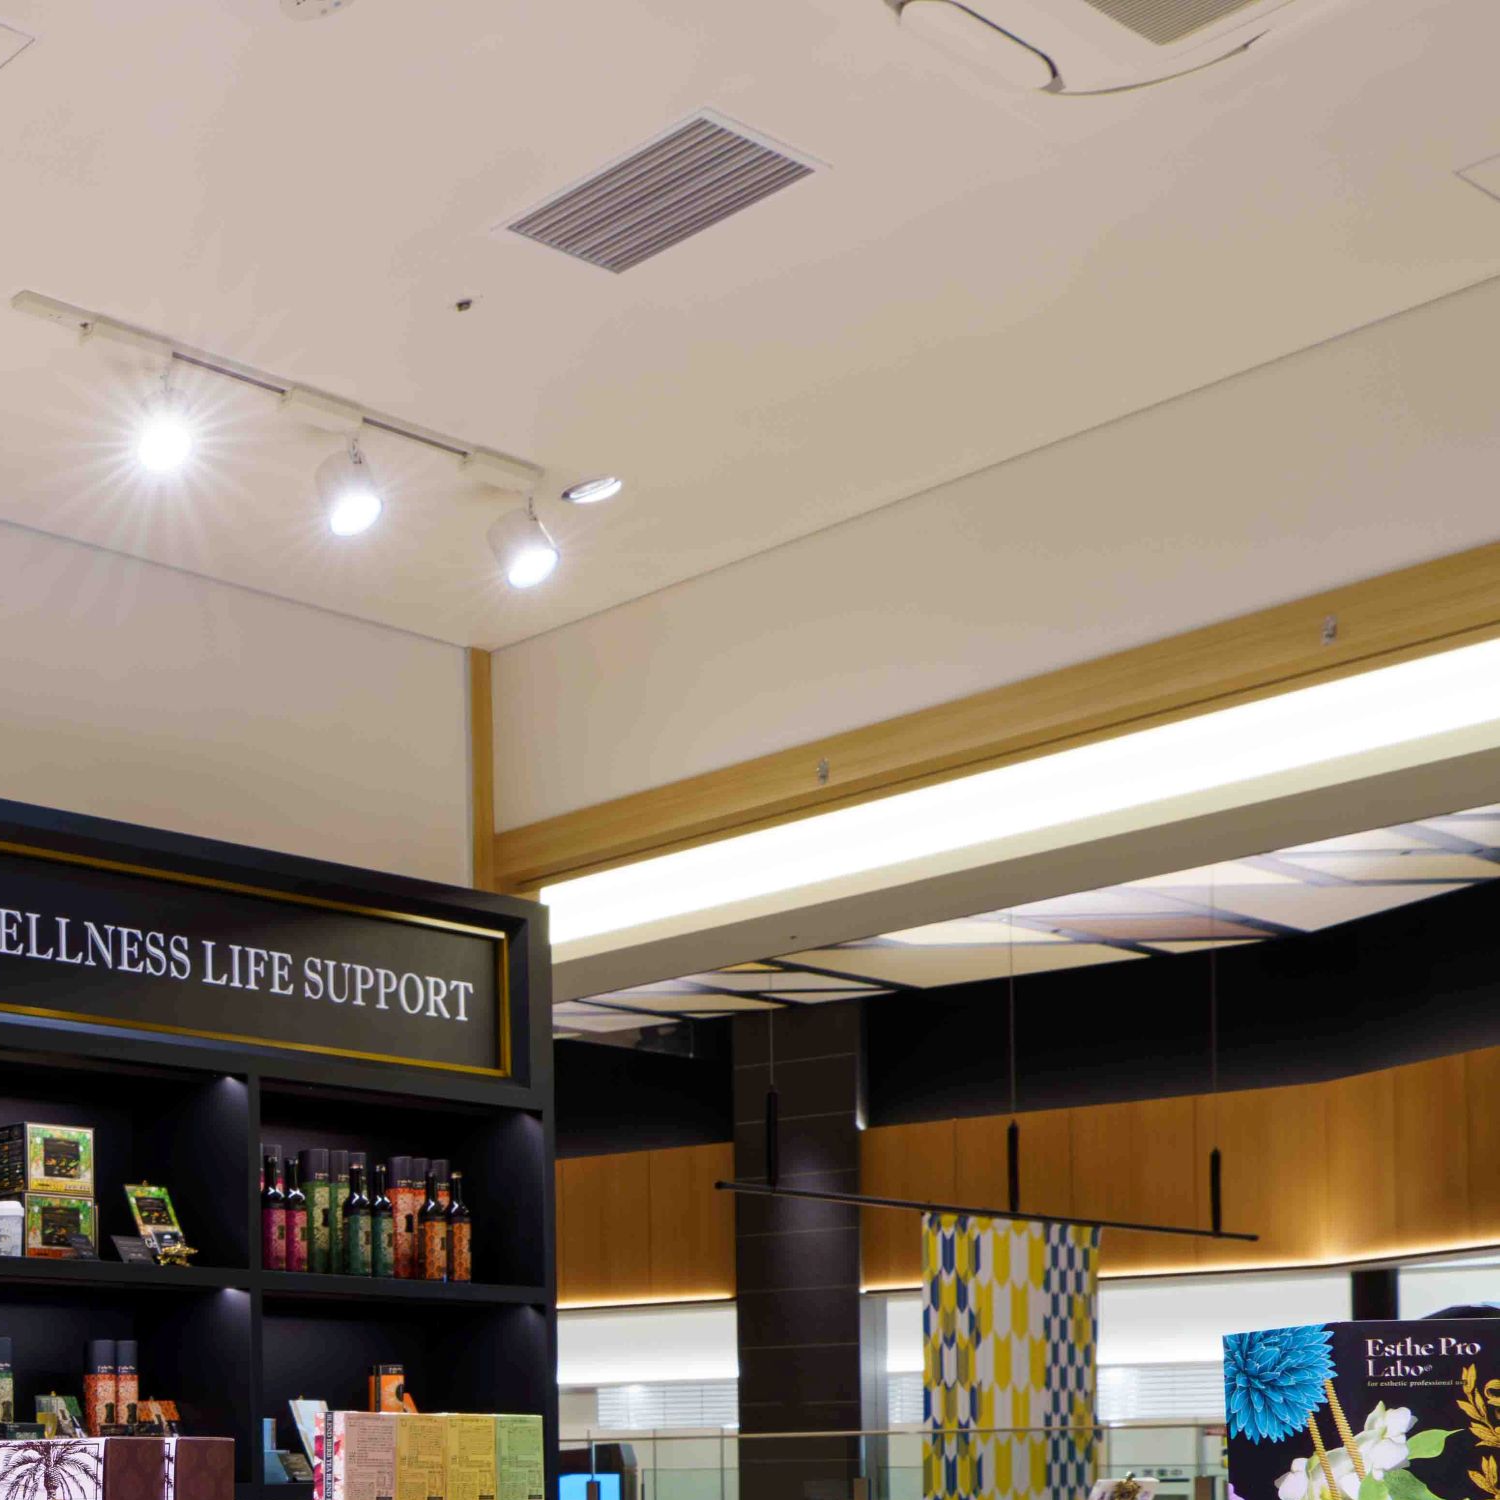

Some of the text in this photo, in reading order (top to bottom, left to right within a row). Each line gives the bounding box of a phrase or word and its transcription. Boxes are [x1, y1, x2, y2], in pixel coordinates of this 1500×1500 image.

[201, 939, 294, 995] LIFE
[304, 956, 474, 1022] SUPPORT
[1365, 1337, 1482, 1358] Esthe Pro
